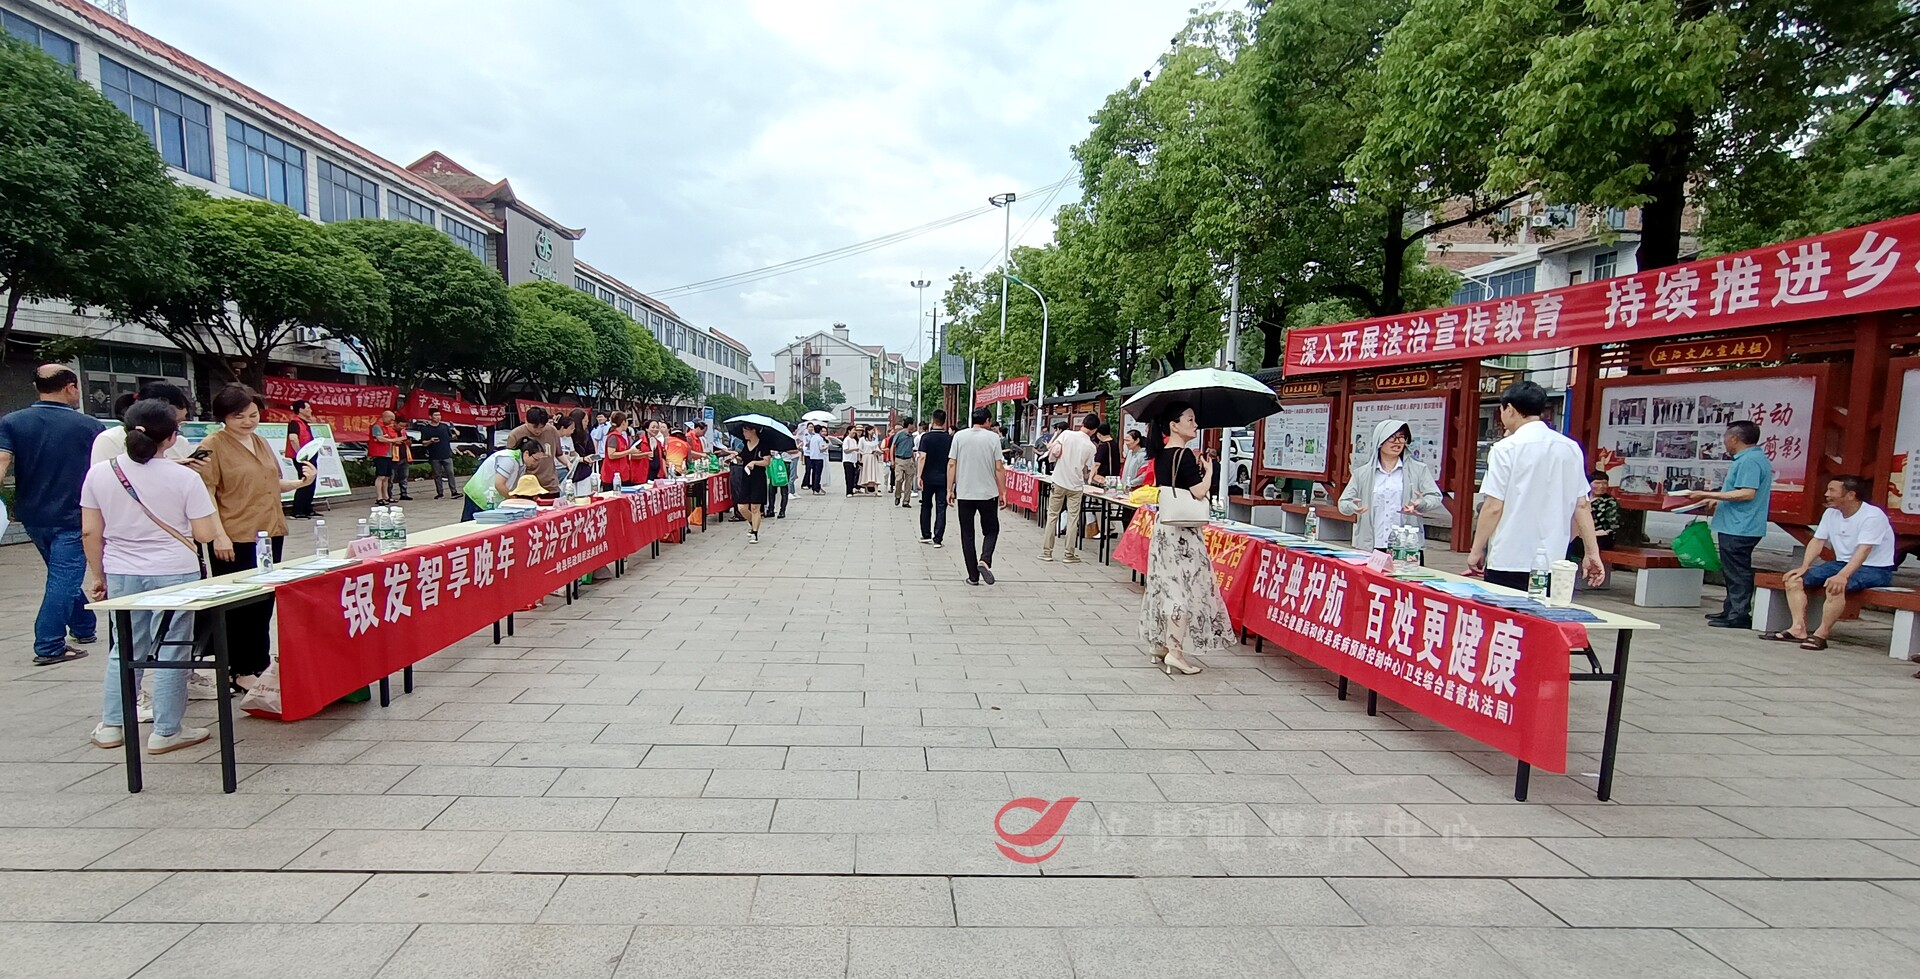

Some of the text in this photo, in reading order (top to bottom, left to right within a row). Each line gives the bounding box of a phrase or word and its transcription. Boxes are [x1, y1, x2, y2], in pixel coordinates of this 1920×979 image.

[1299, 230, 1920, 367] 深入开展法治宣传教育 持续推进乡
[1748, 402, 1794, 427] 活动
[1759, 435, 1802, 461] 剪影
[526, 504, 608, 568] 法治守护钱袋
[340, 534, 516, 638] 银发智享晚年
[1252, 548, 1525, 698] 民法典护航 百姓更健康
